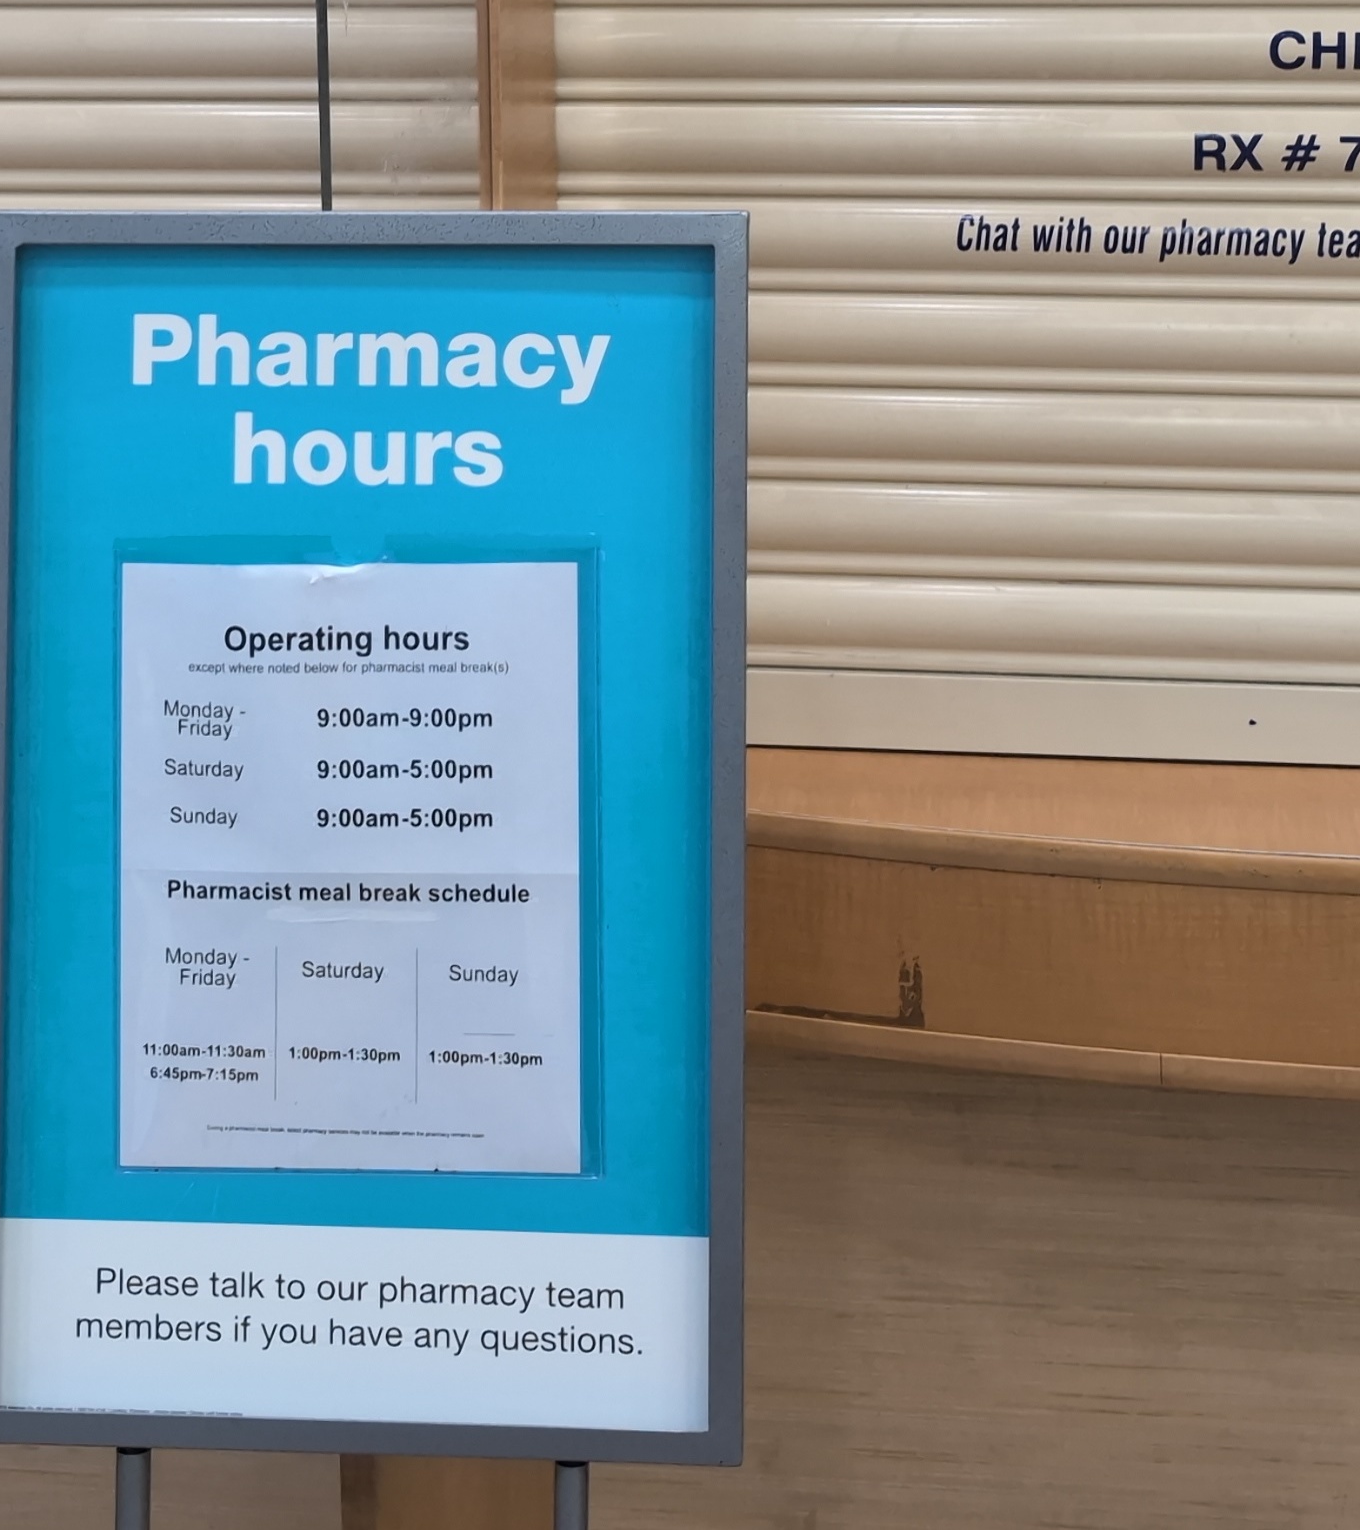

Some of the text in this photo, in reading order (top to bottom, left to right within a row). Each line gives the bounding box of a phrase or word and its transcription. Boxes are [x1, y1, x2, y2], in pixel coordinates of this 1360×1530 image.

[1193, 134, 1264, 173] RX
[1281, 134, 1321, 172] #
[956, 216, 1020, 252] Chat
[1033, 217, 1092, 253] with
[1103, 225, 1150, 255] our
[1159, 218, 1305, 265] pharmacy
[132, 313, 611, 405] Pharmacy
[233, 411, 504, 488] hours
[224, 624, 470, 658] Operating hours
[188, 660, 510, 676] except where noted below for pharmacist meal break(s)
[164, 699, 234, 722] Monday
[317, 707, 493, 733] 9:00am-9:00pm
[178, 718, 233, 741] Friday
[164, 758, 244, 782] Saturday
[317, 759, 493, 784] 9:00am-5:00pm
[170, 806, 238, 829] Sunday
[316, 808, 493, 833] 9:00am-5:00pm
[167, 879, 530, 903] Pharmacist meal break schedule
[165, 947, 238, 967] Monday
[180, 968, 236, 990] Friday
[302, 960, 384, 984] Saturday
[449, 964, 519, 987] Sunday
[142, 1043, 266, 1059] 11:00am-11:30am
[289, 1046, 401, 1064] 1:00pm-1:30pm
[429, 1050, 543, 1068] 1:00pm-1:30pm
[150, 1066, 259, 1084] 6:45pm-7:15pm
[96, 1267, 624, 1314] Please talk to our pharmacy team
[76, 1313, 643, 1358] members if you have any questions.
